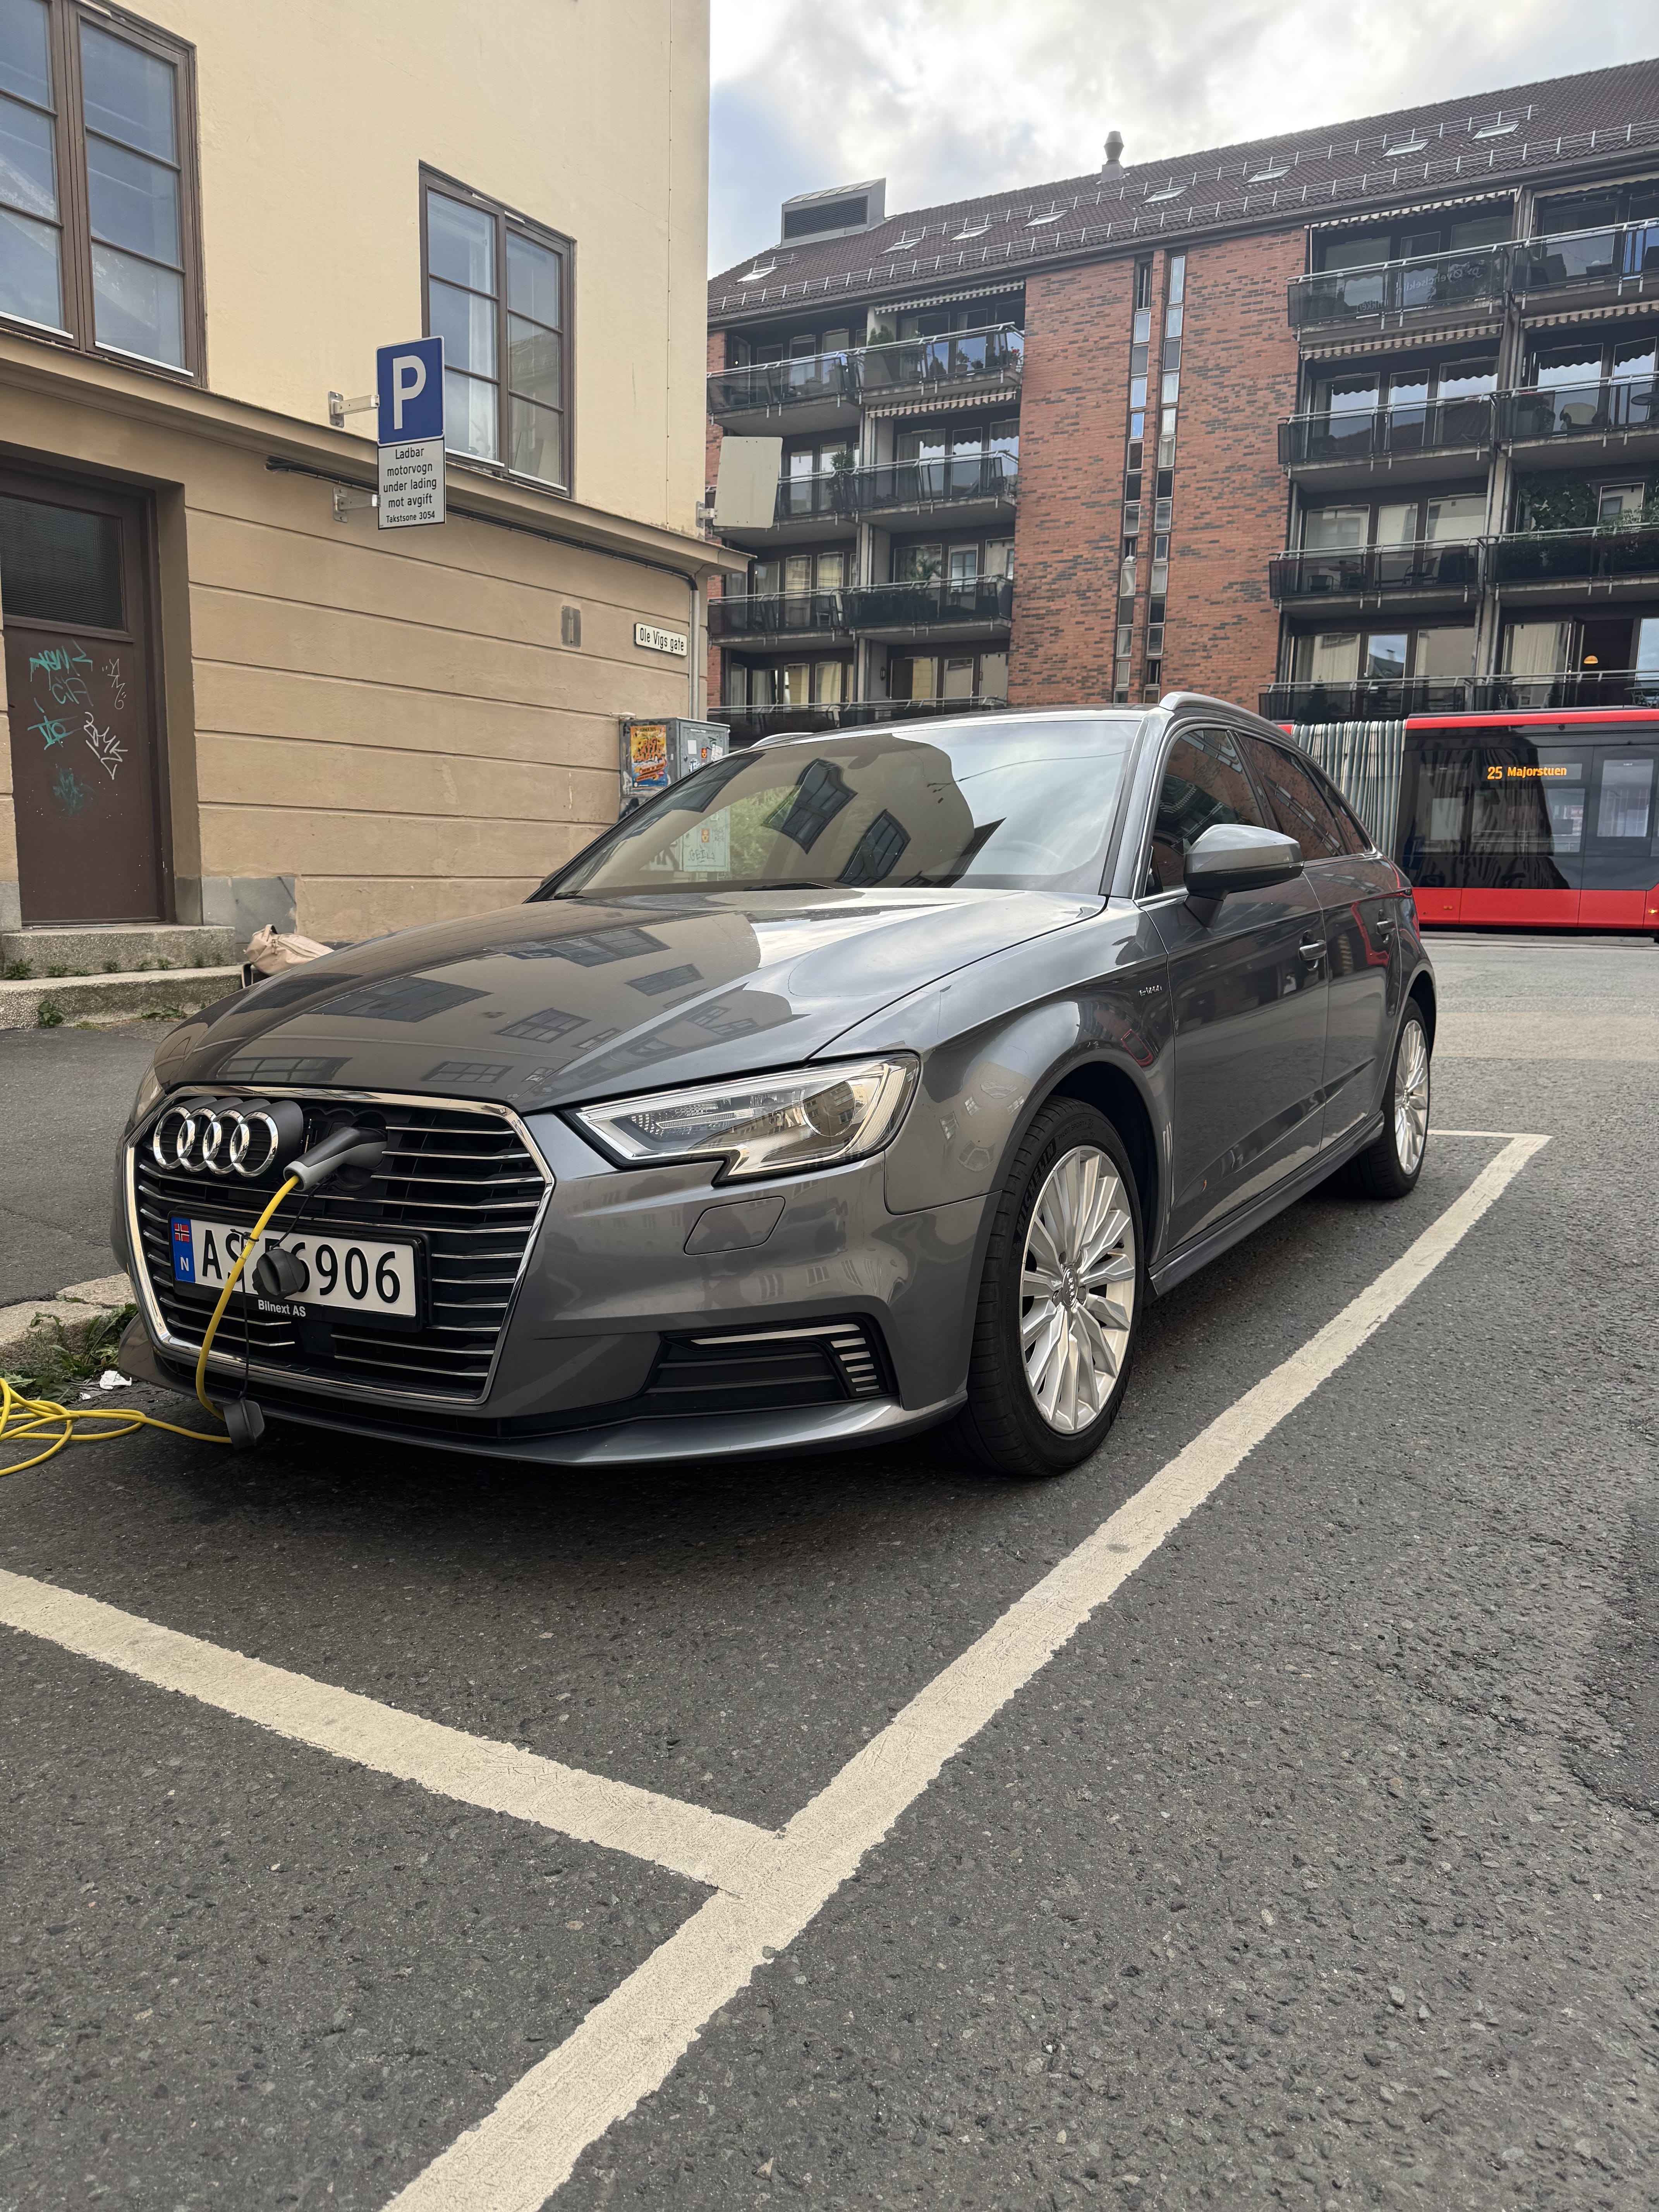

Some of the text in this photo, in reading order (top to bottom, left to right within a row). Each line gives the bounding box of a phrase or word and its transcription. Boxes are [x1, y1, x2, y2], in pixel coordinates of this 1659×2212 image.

[393, 355, 426, 430] P
[395, 447, 424, 459] Ladbar
[387, 463, 433, 477] motorvogn
[383, 477, 437, 493] under lading
[388, 493, 433, 508] mot avgift
[386, 510, 435, 523] Takstsone 3054
[640, 627, 684, 652] Ole Vigs gate
[1487, 766, 1567, 780] 25 Majorstuen
[180, 1257, 189, 1271] N
[264, 1237, 401, 1304] 6906
[258, 1299, 306, 1317] Bilnext AS
